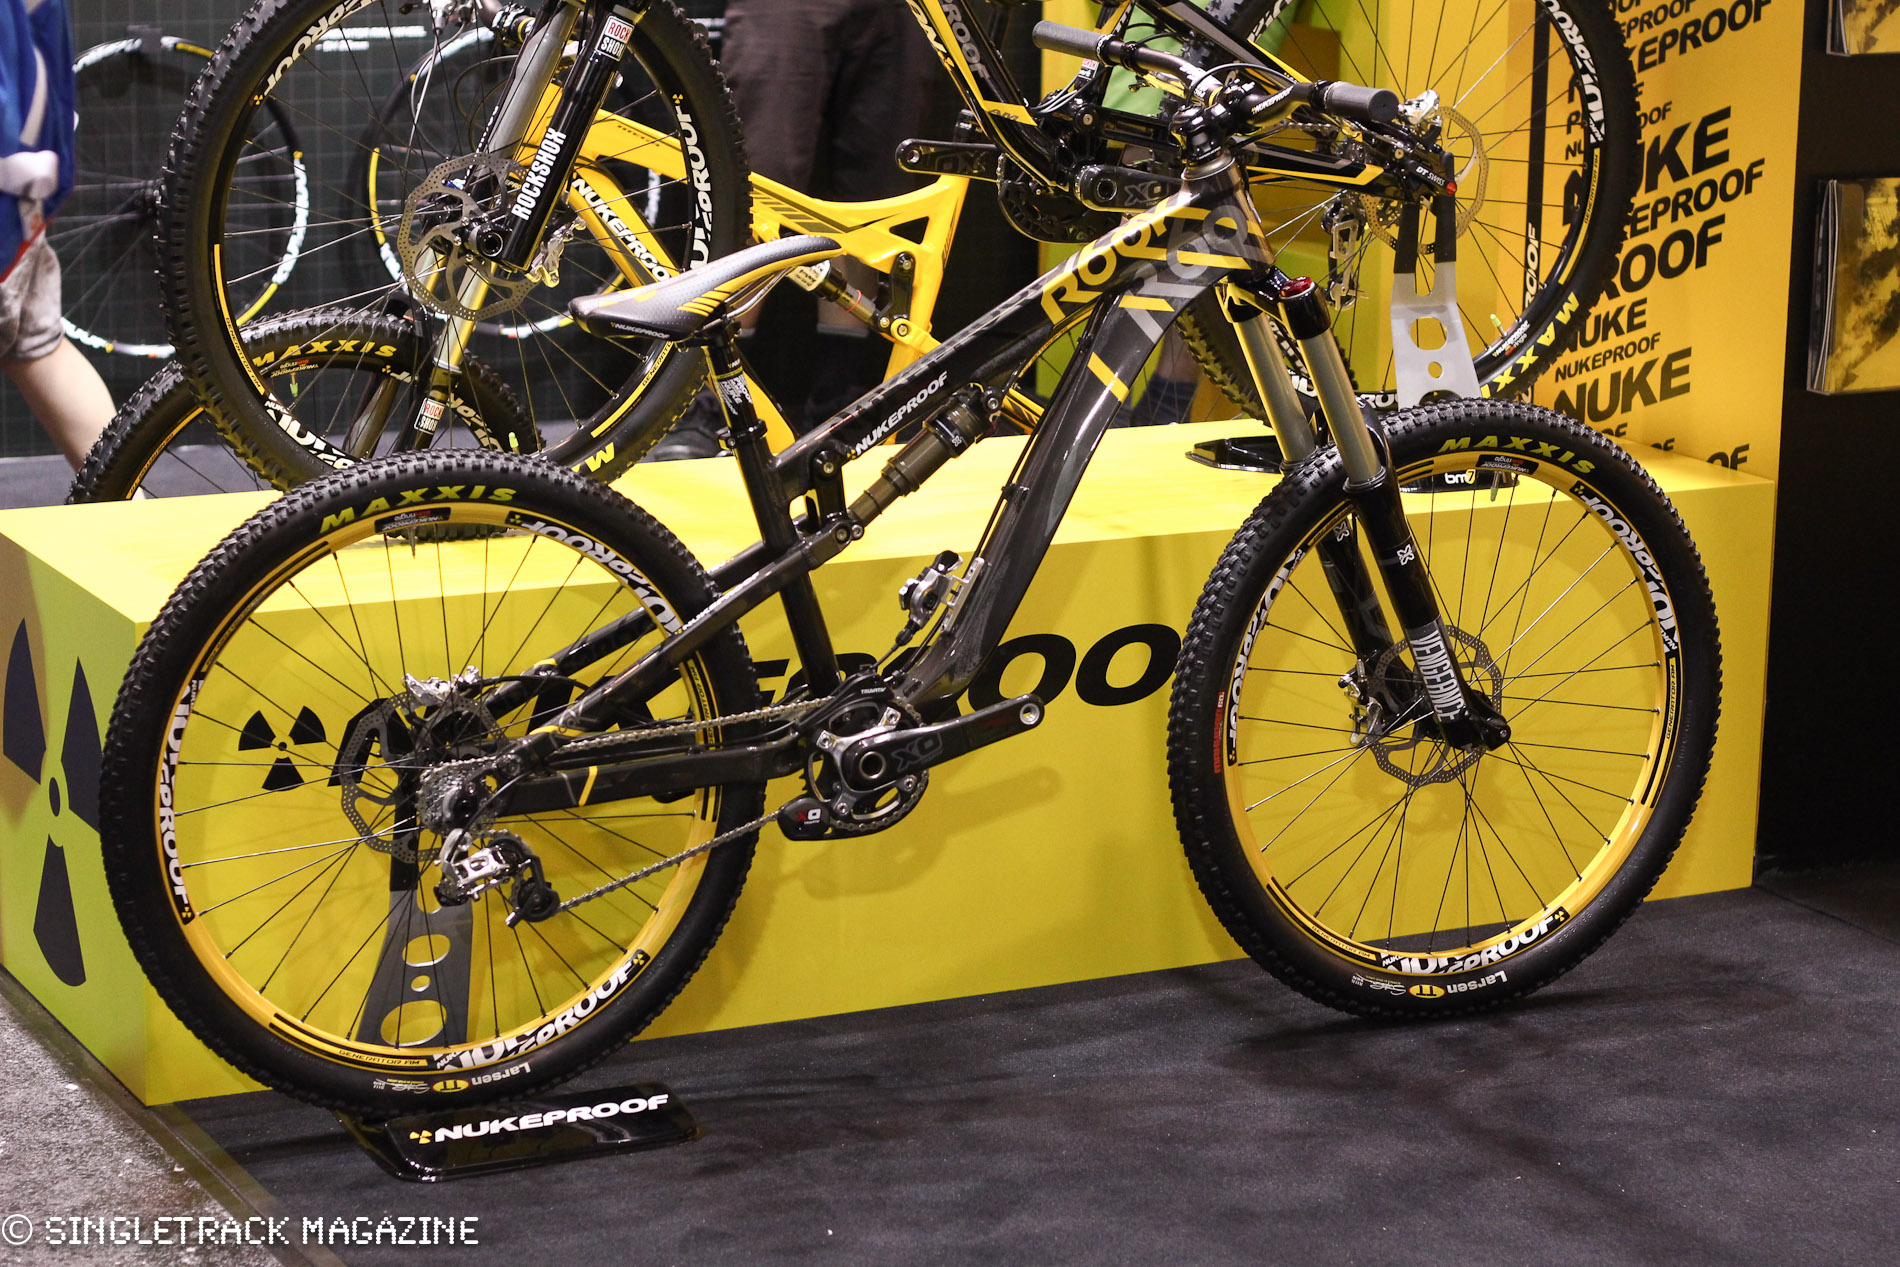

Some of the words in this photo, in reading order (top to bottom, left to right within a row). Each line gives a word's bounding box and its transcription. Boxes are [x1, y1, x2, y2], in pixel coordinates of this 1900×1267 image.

[607, 22, 633, 42] ROCK
[1628, 0, 1772, 73] EPROOF
[1253, 85, 1294, 115] NUKEPROOF
[511, 127, 567, 221] ROCKSHOX
[1415, 166, 1427, 176] DT
[1427, 172, 1445, 187] SWISS
[572, 177, 674, 283] NUKEPROO
[252, 339, 397, 368] MAXXIS
[614, 323, 670, 339] NUKEPROOF
[1480, 291, 1580, 400] MAXXI
[1554, 332, 1661, 382] NUKEPROOF
[855, 370, 949, 456] NUKEPROOF
[1437, 435, 1596, 474] MAXXIS
[319, 485, 517, 534] MAXXIS
[1410, 629, 1466, 722] VENGEANCE
[1666, 680, 1676, 740] GENERATOR
[1446, 970, 1509, 994] Larsen
[338, 1049, 402, 1065] GENERATOR
[471, 1062, 532, 1086] Larsen
[434, 1094, 669, 1142] NUKEPROOF
